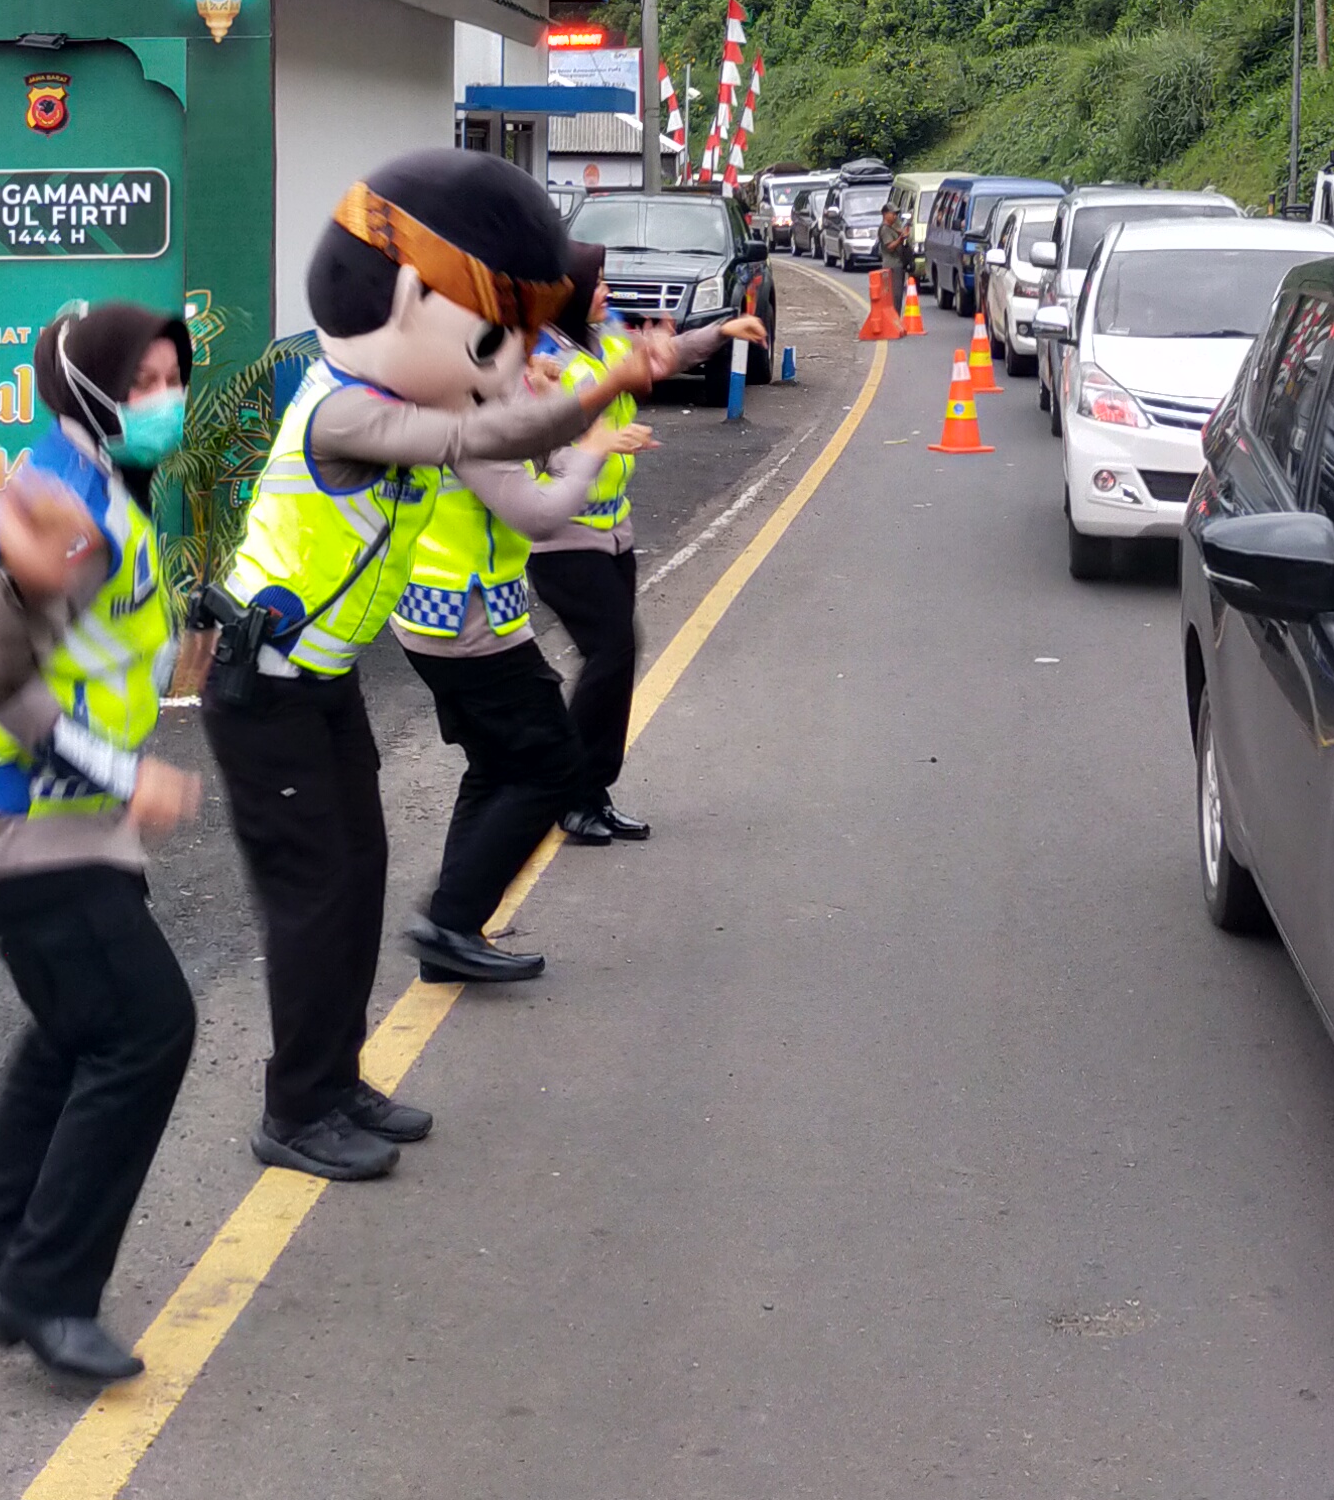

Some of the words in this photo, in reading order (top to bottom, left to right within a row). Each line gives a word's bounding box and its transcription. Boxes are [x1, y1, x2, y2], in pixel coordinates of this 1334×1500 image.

[52, 205, 127, 226] FIRTI
[8, 228, 62, 244] 1444
[70, 228, 85, 244] H
